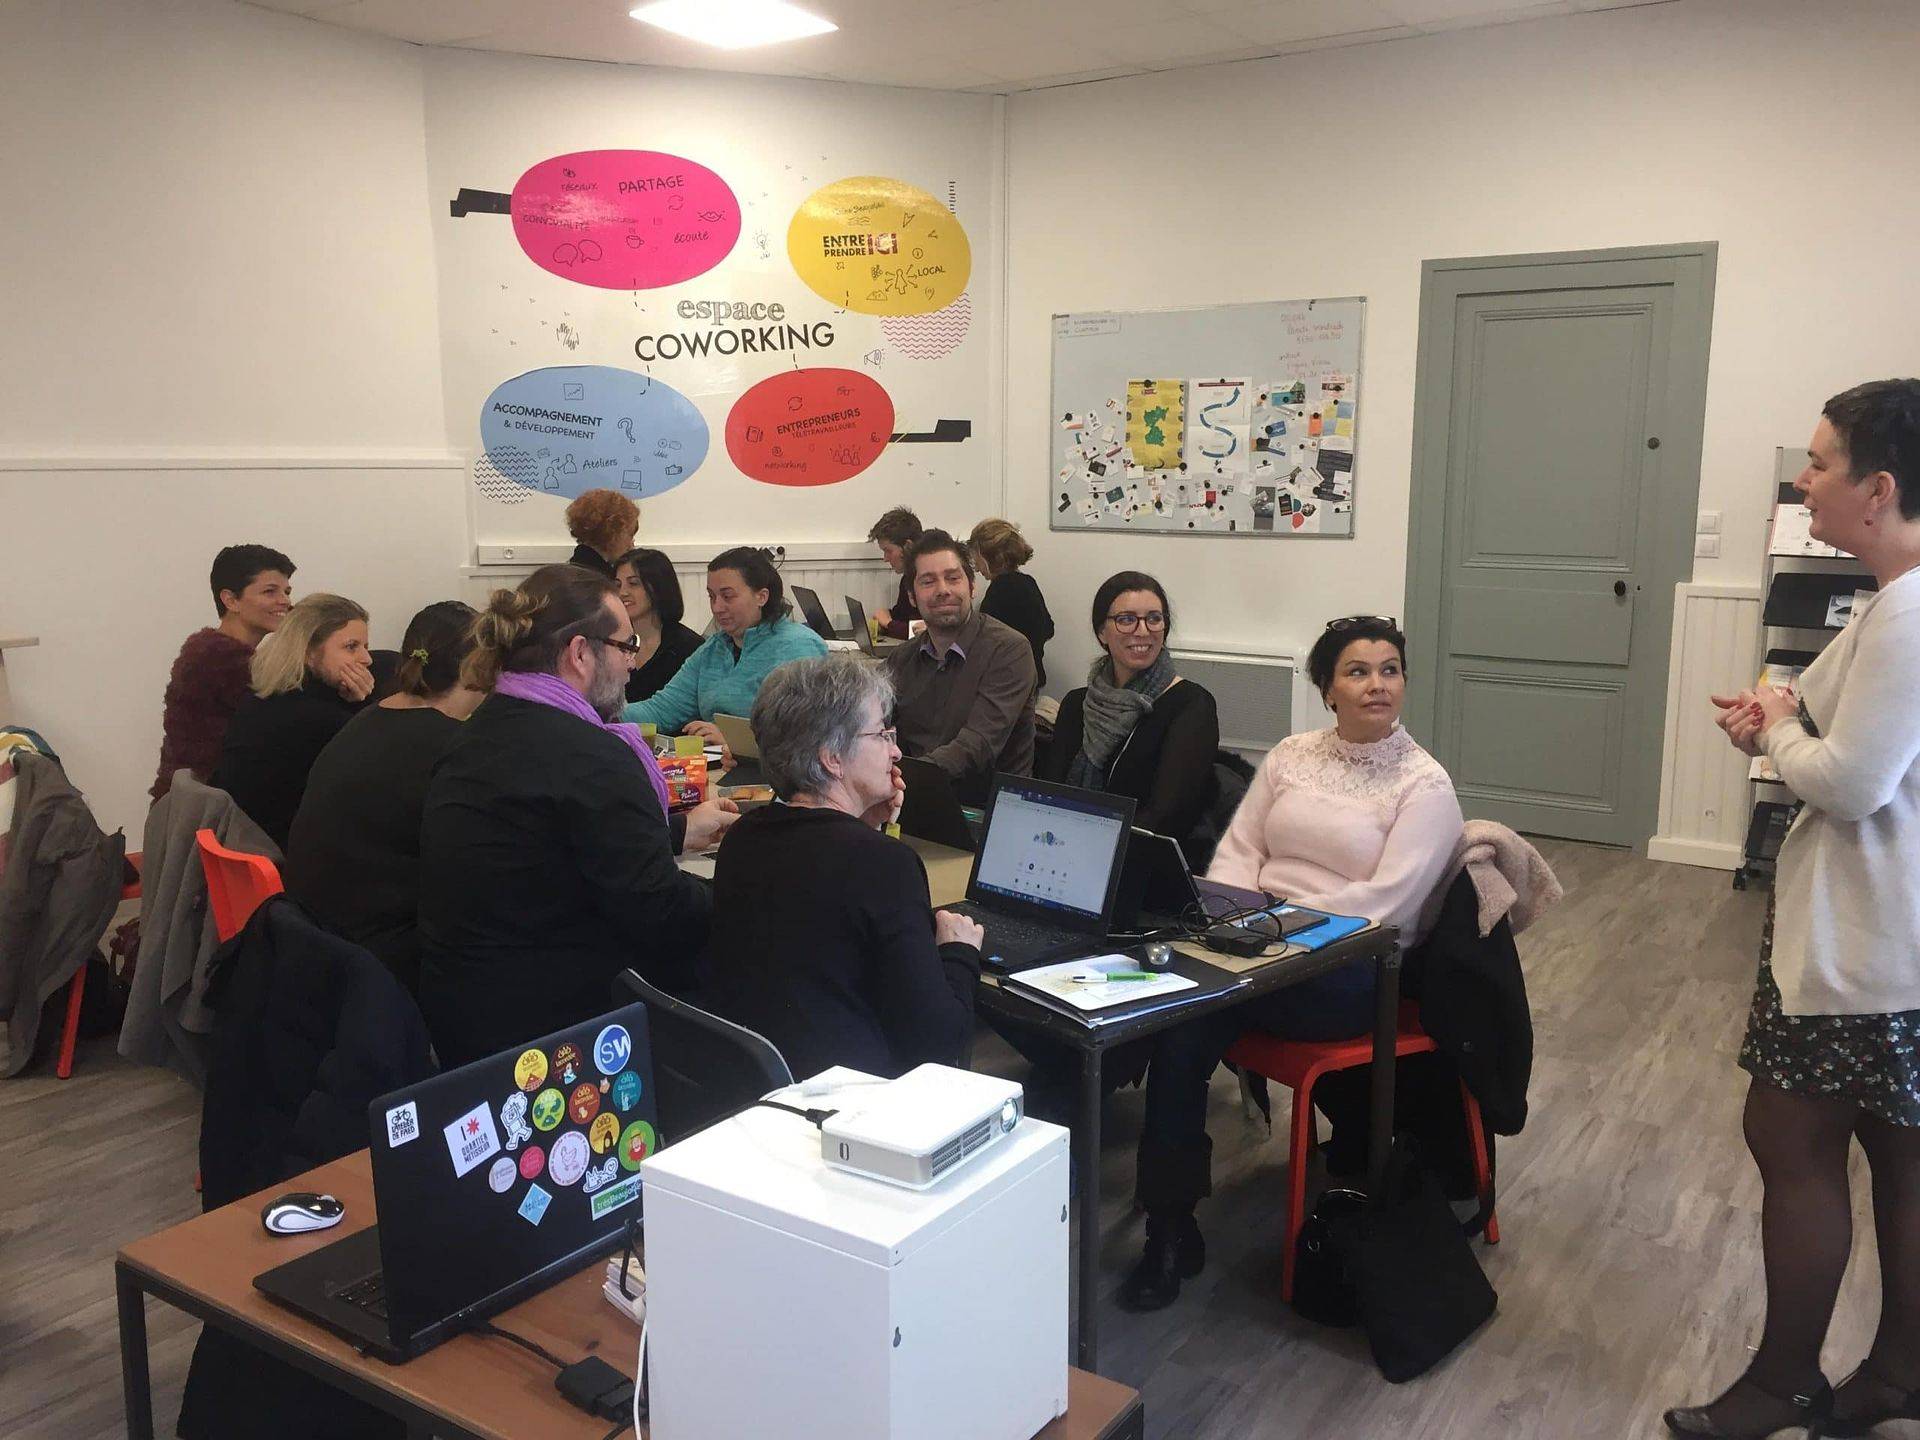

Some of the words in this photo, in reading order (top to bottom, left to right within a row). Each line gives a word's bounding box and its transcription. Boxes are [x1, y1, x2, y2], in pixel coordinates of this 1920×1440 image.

[618, 175, 684, 195] PARTAGE
[823, 234, 865, 248] ENTRE
[824, 248, 867, 257] PRENDRE
[917, 265, 946, 277] LOCAL
[677, 300, 785, 326] espace
[634, 322, 835, 362] COWORKING
[493, 402, 603, 427] ACCOMPAGNEMENT
[776, 407, 862, 435] ENTREPRENEURS
[503, 419, 512, 428] &
[515, 420, 595, 440] DÉVELOPPEMENT
[601, 1035, 630, 1064] SW
